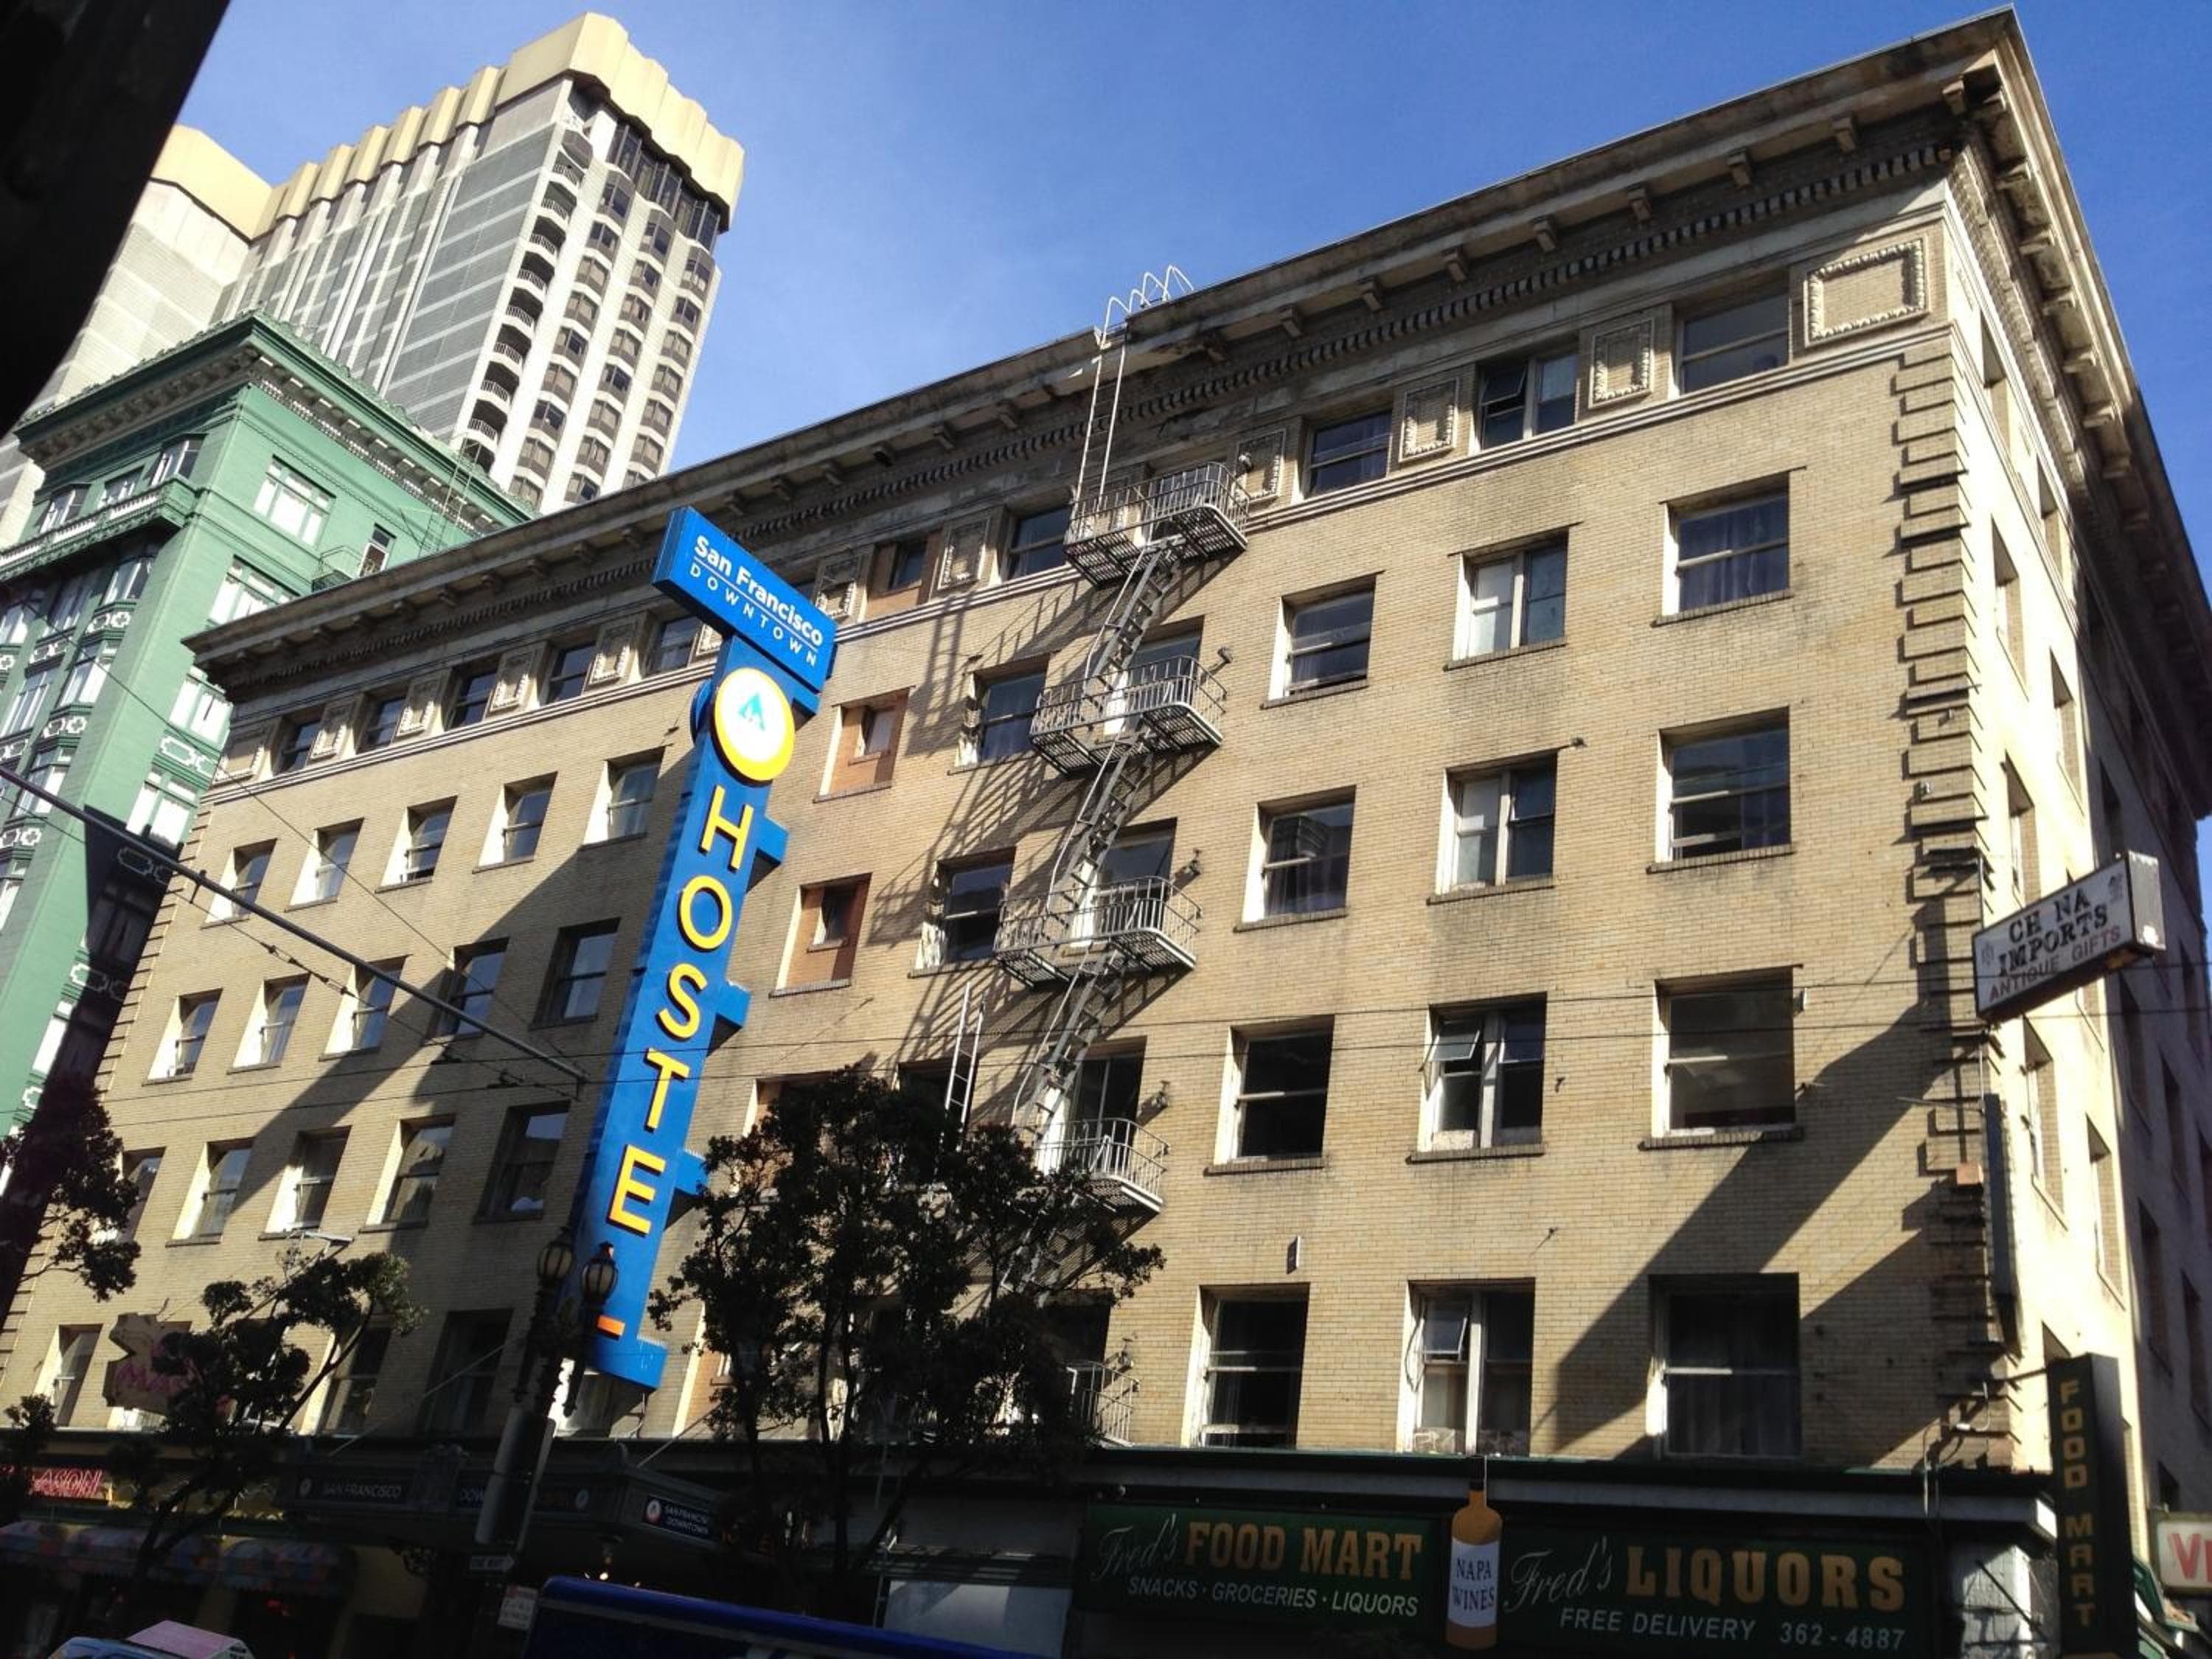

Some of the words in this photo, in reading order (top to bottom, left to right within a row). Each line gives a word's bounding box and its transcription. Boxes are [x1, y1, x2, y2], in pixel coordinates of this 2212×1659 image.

[689, 563, 817, 667] DOWNTOWN
[694, 535, 732, 577] San
[737, 566, 824, 647] Francisco
[1989, 956, 2060, 1002] ANTIQUE
[2071, 926, 2120, 962] GIFTS
[1998, 904, 2107, 978] IMPORTS
[2060, 1380, 2087, 1489] FOOD
[1091, 1513, 1180, 1582] Fred's
[1184, 1521, 1286, 1571] FOOD
[1299, 1527, 1423, 1582] MART
[1456, 1557, 1492, 1581] NAPA
[1503, 1535, 1613, 1613] Fred's
[1627, 1545, 1906, 1613] LIQUORS
[2065, 1513, 2096, 1627] MART
[1127, 1575, 1198, 1600] SNACKS
[1211, 1582, 1317, 1609] GROCERIES
[1332, 1590, 1419, 1618] LIQUORS
[1452, 1585, 1495, 1612] WINES
[1559, 1607, 1624, 1632] FREE
[1632, 1613, 1756, 1641] DELIVERY
